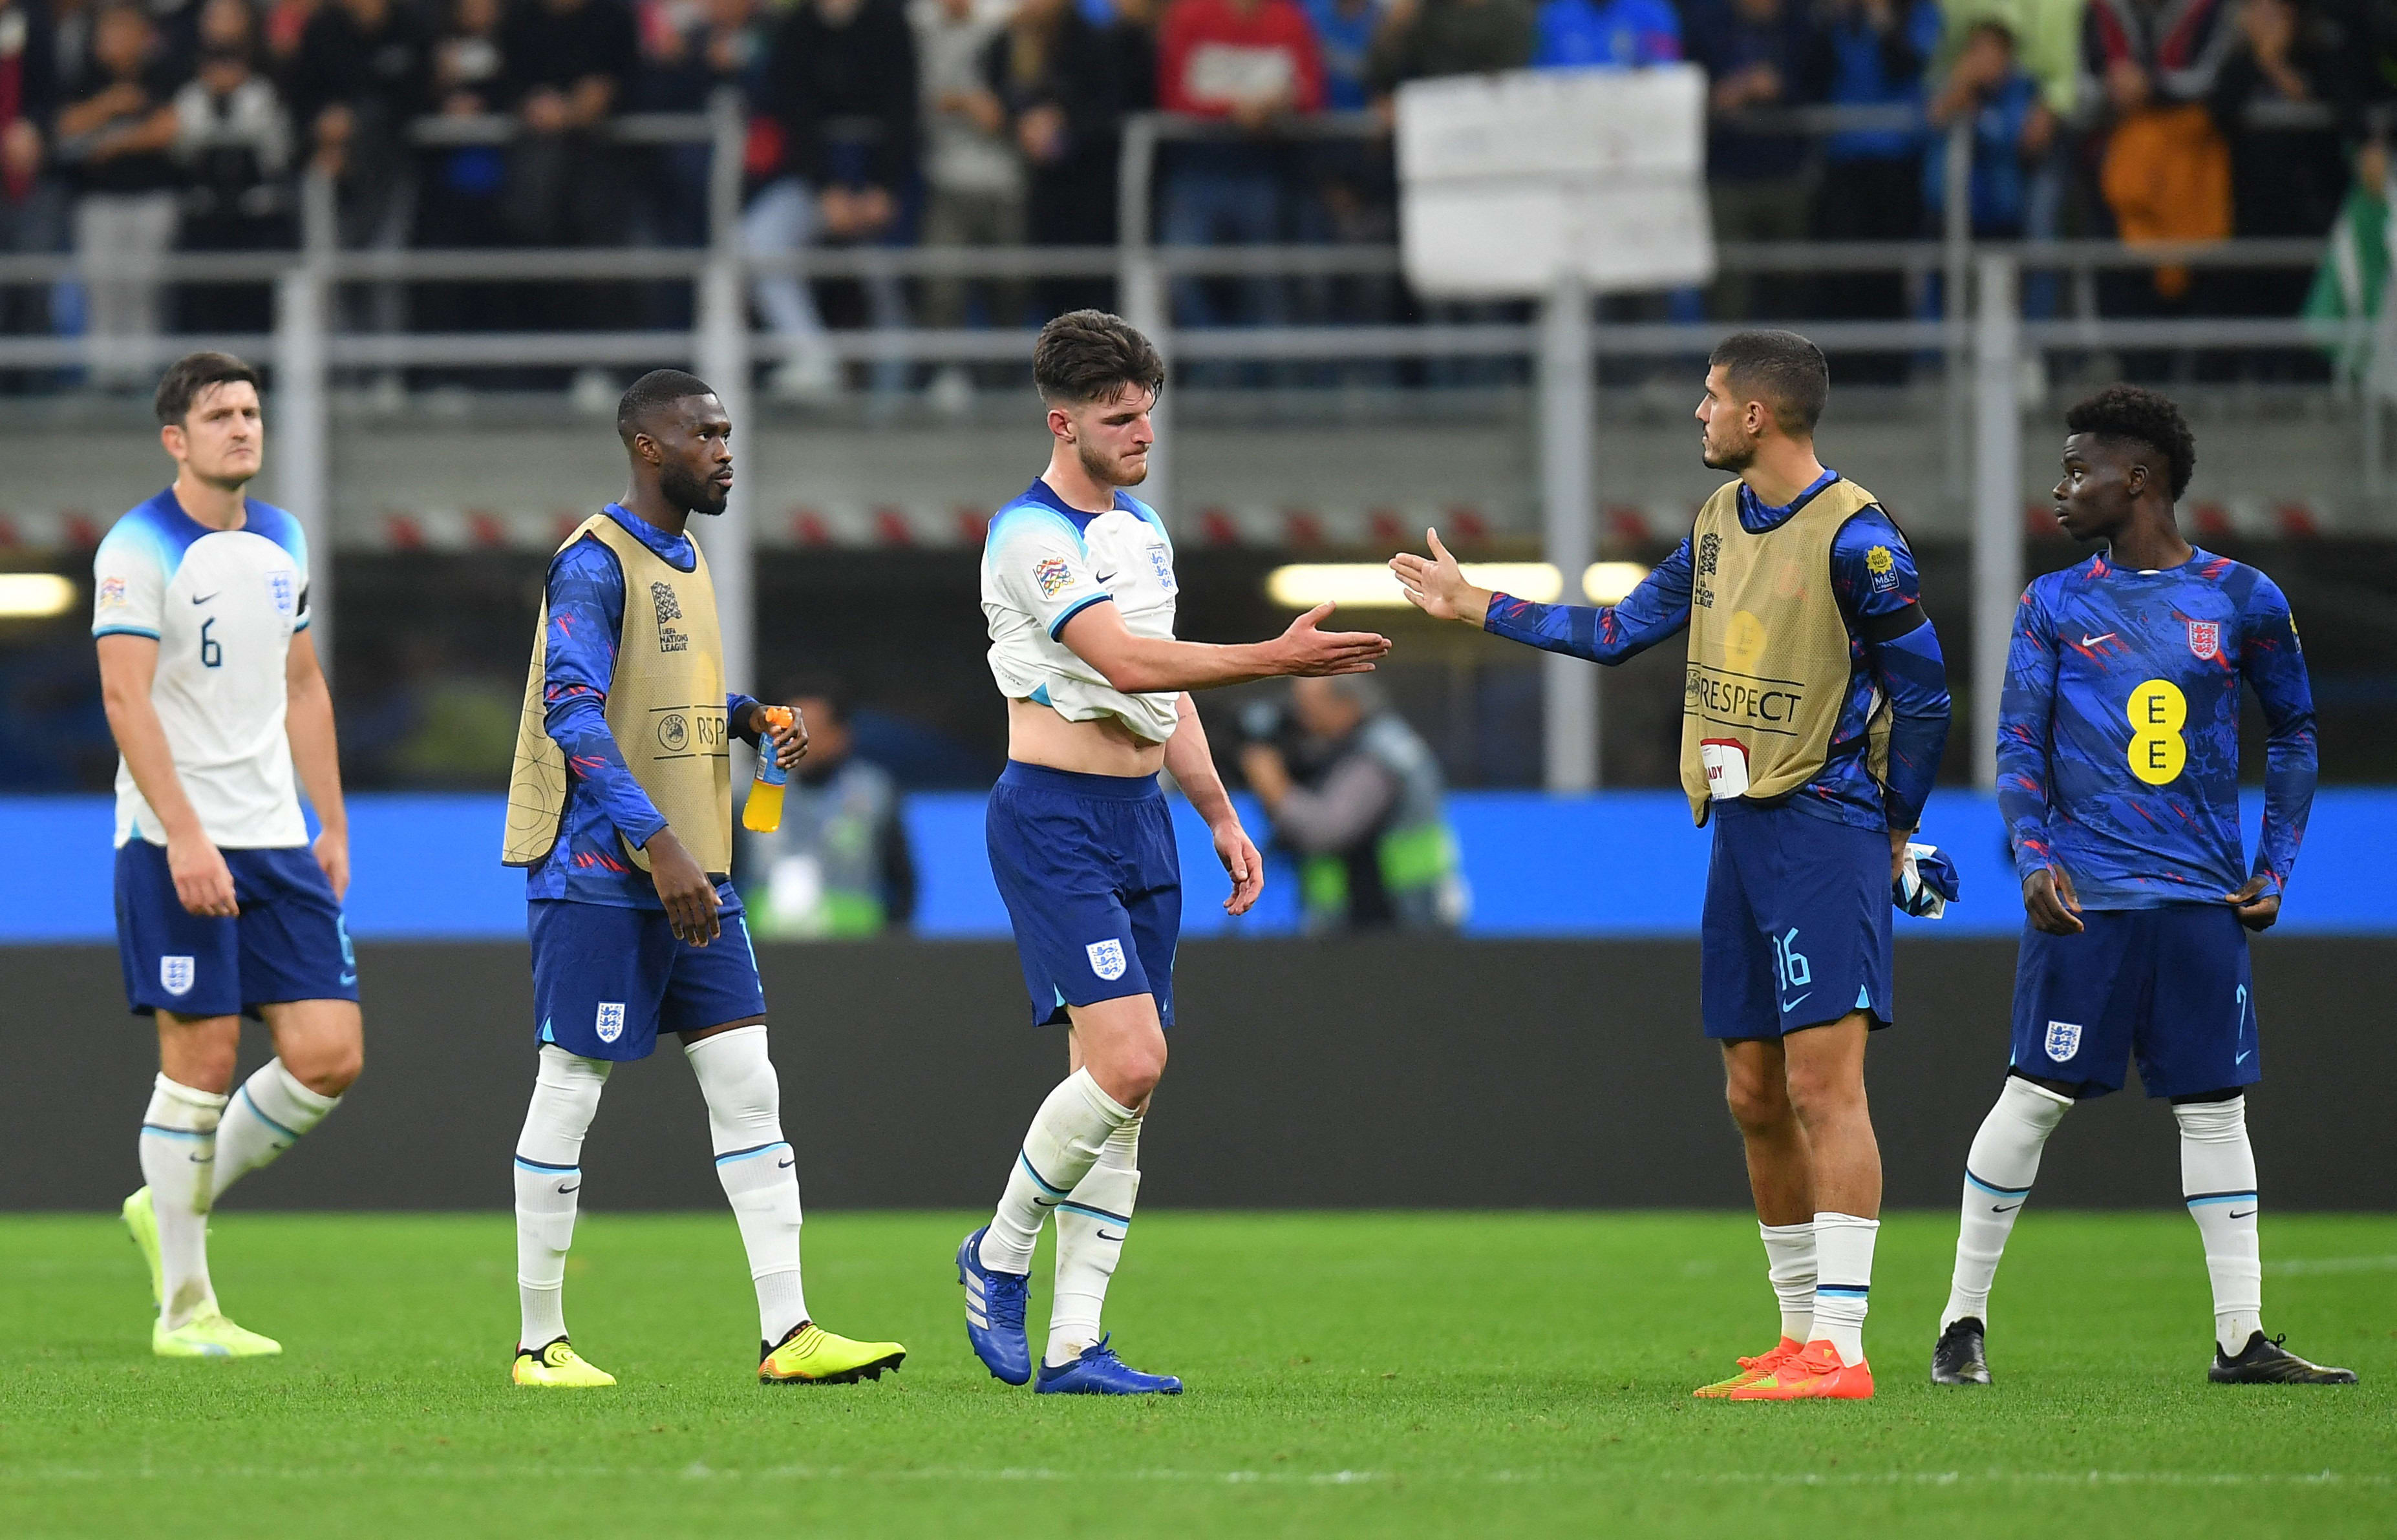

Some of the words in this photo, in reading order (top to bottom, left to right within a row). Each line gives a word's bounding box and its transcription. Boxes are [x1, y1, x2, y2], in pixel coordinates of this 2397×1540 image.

[1875, 573, 1895, 585] M&S
[202, 617, 221, 667] 6
[660, 634, 688, 643] NATIONS
[661, 643, 688, 653] LEAGUE
[1700, 677, 1802, 723] RESPECT
[1708, 765, 1723, 780] ADY
[1773, 927, 1811, 991] 16
